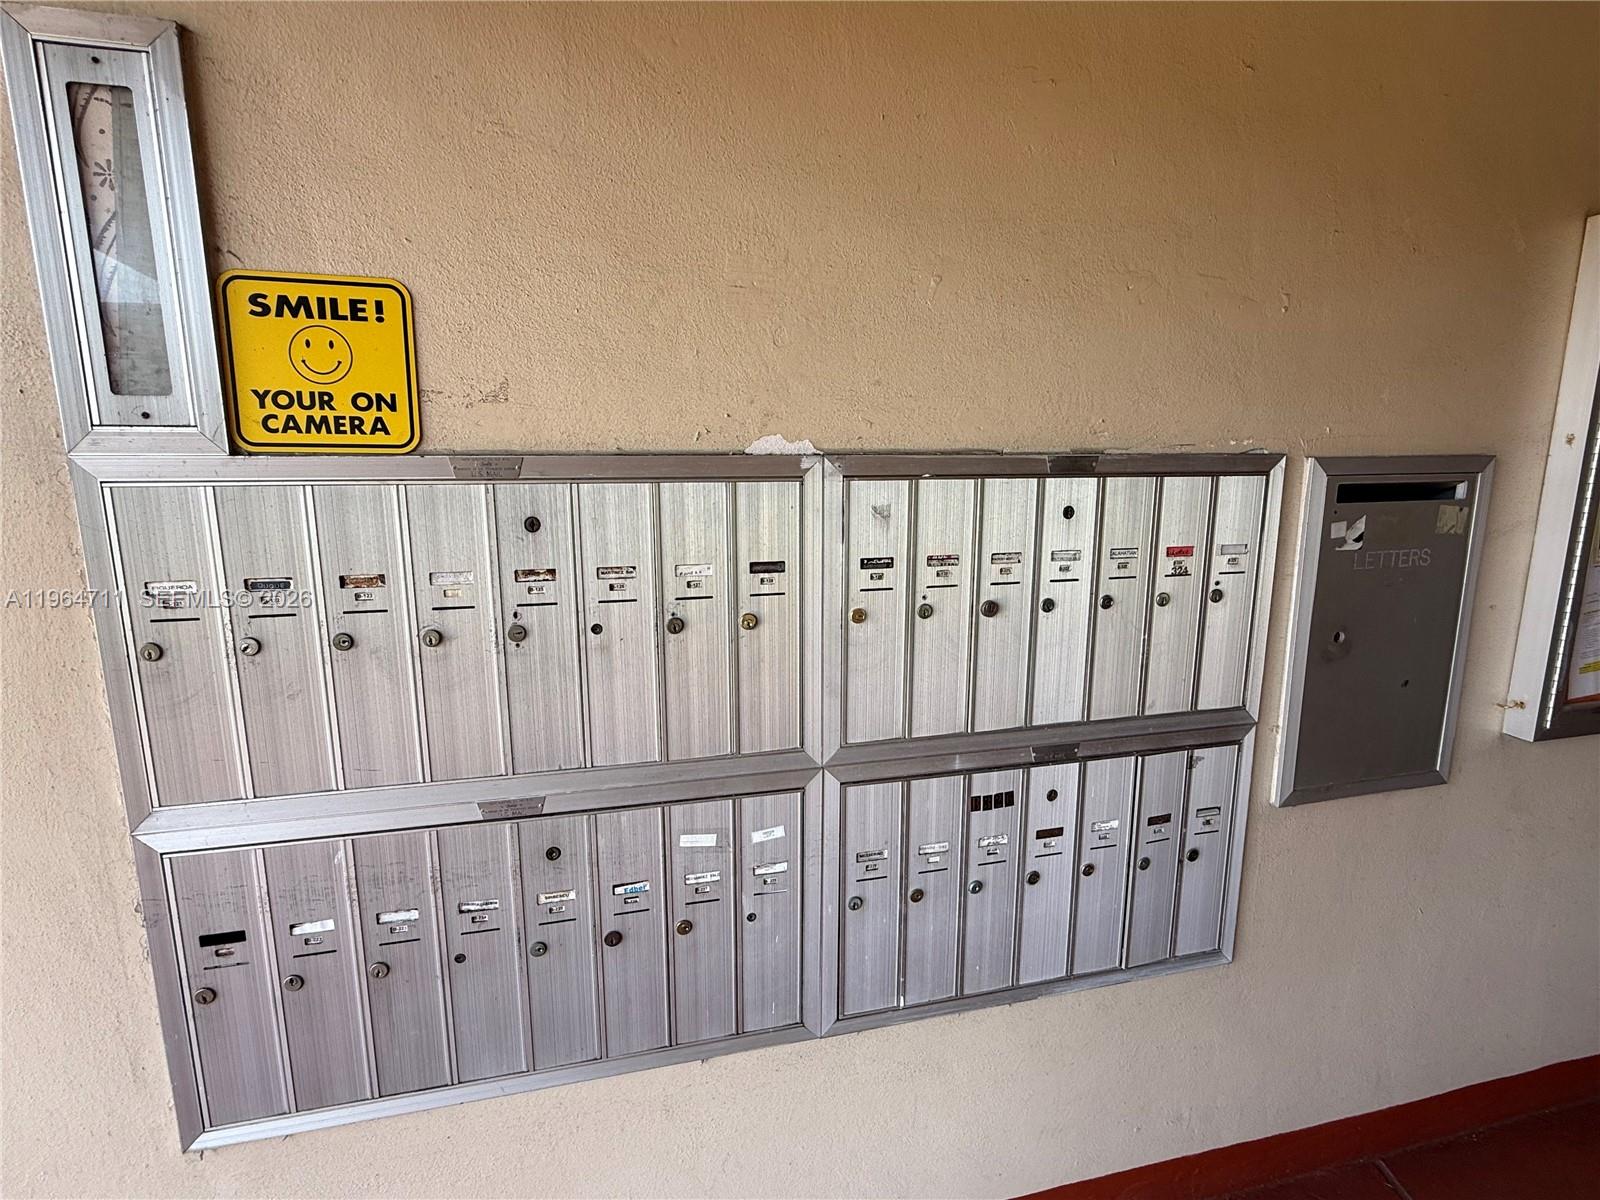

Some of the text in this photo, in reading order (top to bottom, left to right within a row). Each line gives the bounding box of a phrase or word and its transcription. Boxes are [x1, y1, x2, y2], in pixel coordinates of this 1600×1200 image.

[248, 293, 385, 323] SMILE!
[251, 389, 398, 413] YOUR ON
[261, 414, 391, 436] CAMERA
[1353, 548, 1432, 570] LETTERS
[1171, 566, 1189, 575] 324
